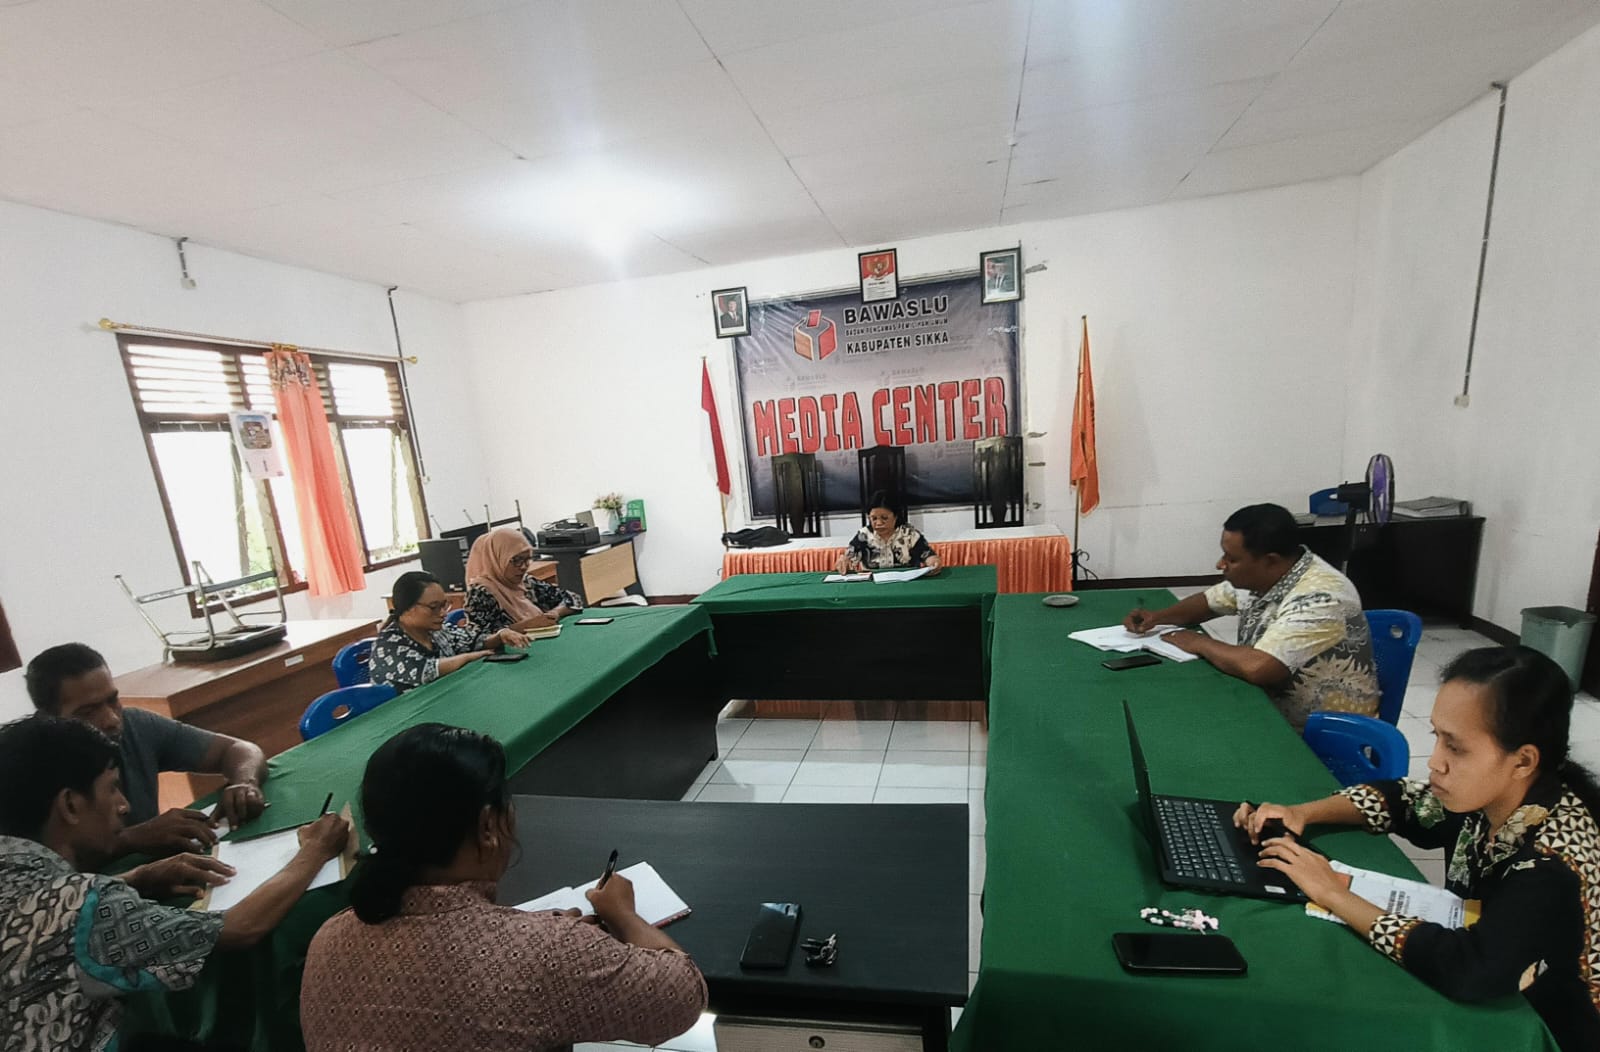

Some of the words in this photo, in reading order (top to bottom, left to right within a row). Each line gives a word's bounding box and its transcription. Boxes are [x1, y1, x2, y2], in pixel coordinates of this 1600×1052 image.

[844, 296, 949, 325] BAWASLU
[847, 336, 911, 355] KABUPATEN
[915, 331, 949, 347] SIKKA
[753, 391, 864, 457] MEDIA
[872, 376, 1008, 447] CENTER
